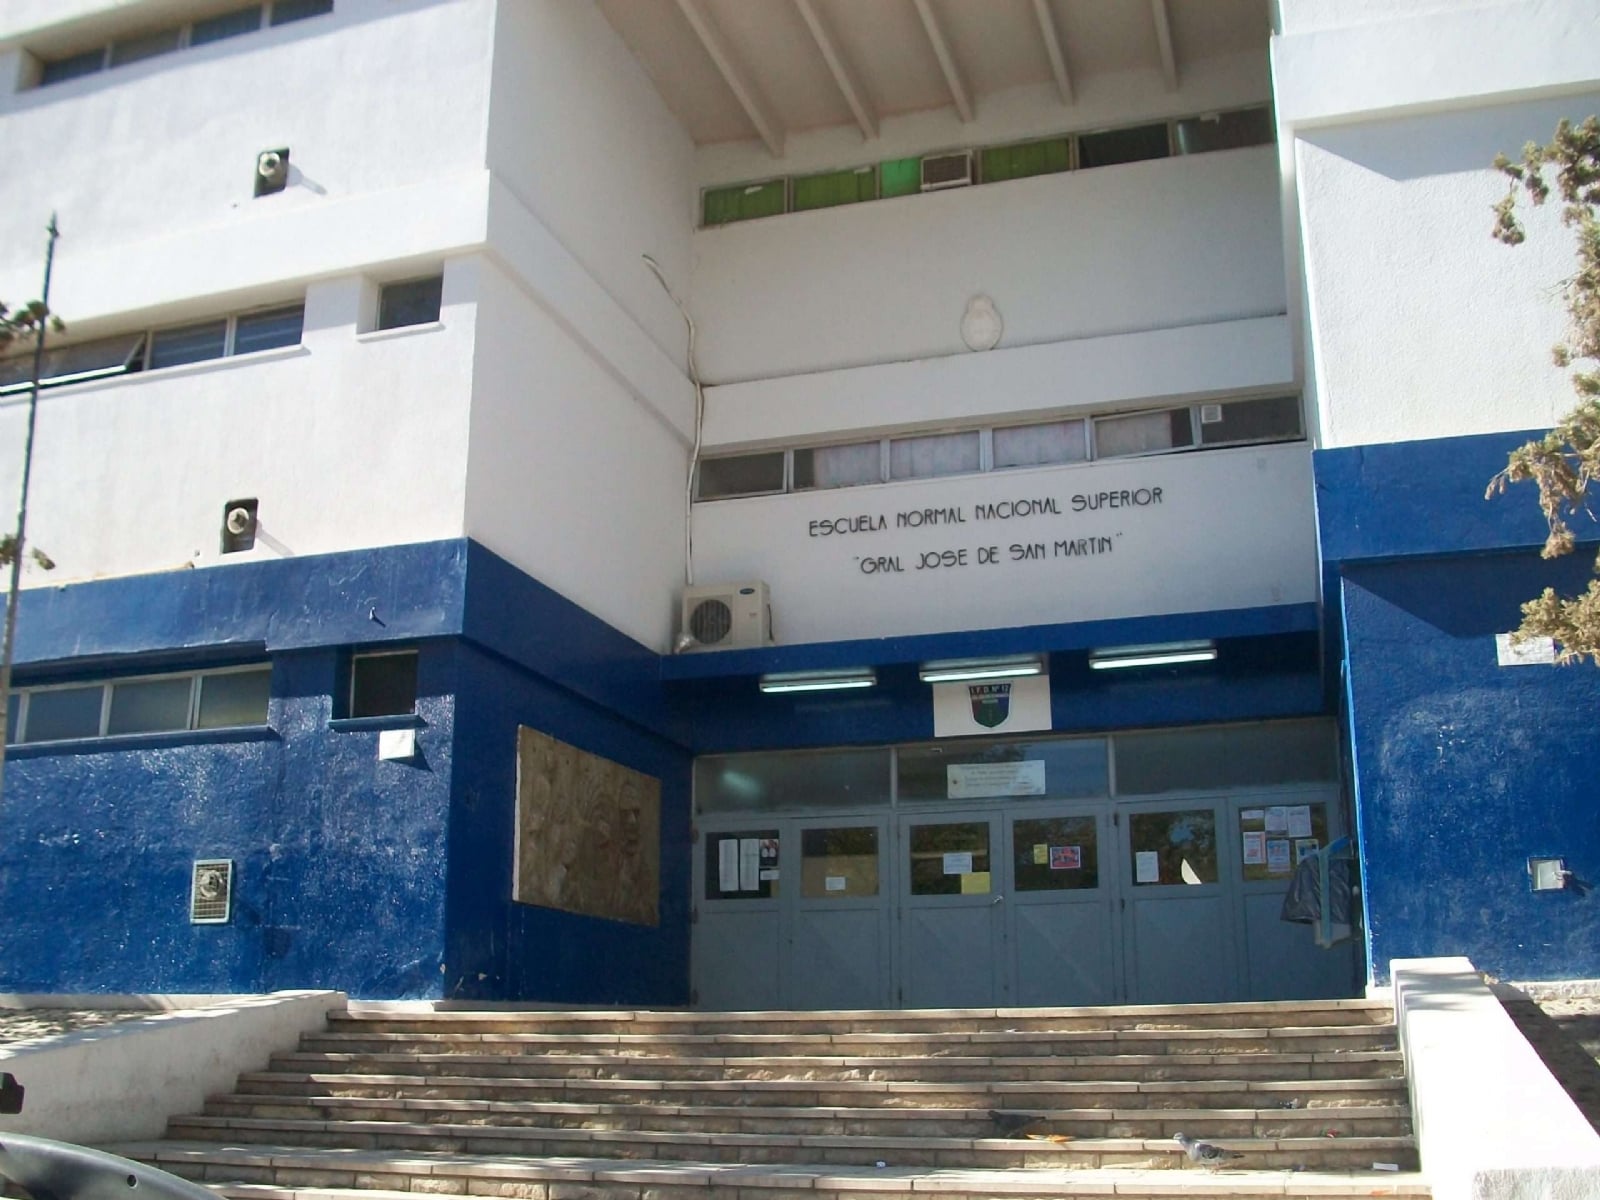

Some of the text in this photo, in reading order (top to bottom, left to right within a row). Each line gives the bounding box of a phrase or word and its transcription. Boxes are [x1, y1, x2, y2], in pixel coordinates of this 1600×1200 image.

[809, 487, 1163, 537] ESCUELA NORMAL NACIONAL SUPERIOR
[915, 550, 968, 570] JOSE
[977, 545, 1000, 565] DE
[1009, 543, 1046, 561] SAN
